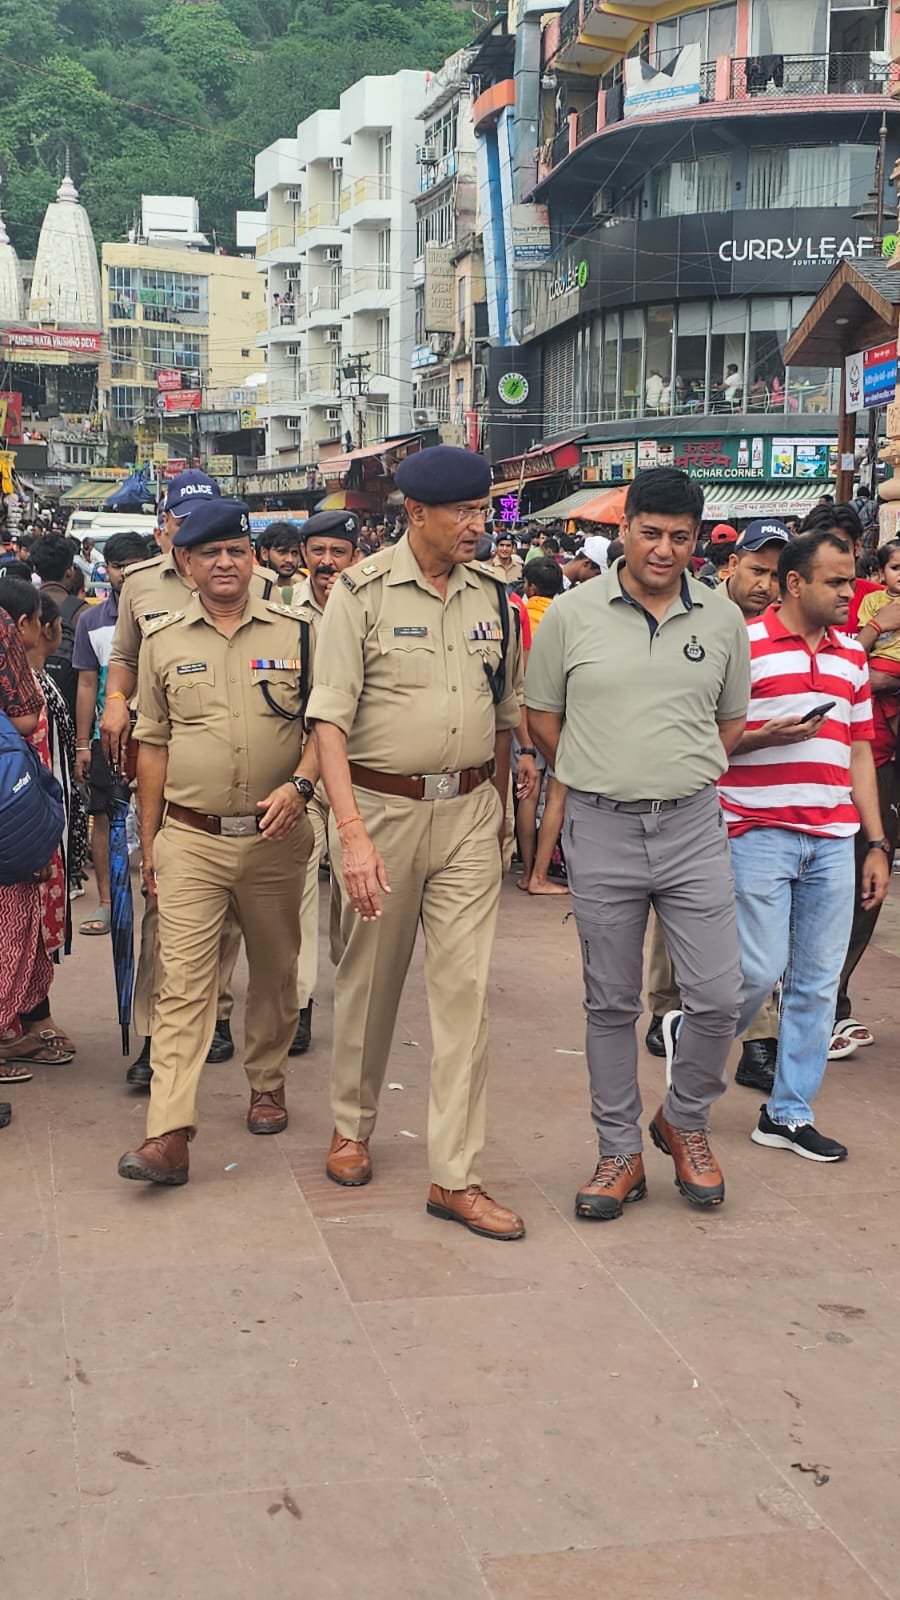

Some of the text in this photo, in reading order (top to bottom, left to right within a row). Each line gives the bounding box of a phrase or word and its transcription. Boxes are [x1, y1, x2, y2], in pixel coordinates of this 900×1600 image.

[719, 236, 875, 262] CURRY LEAF
[690, 468, 723, 478] ACHAR
[724, 468, 764, 478] CORNER
[180, 484, 213, 497] POLICE
